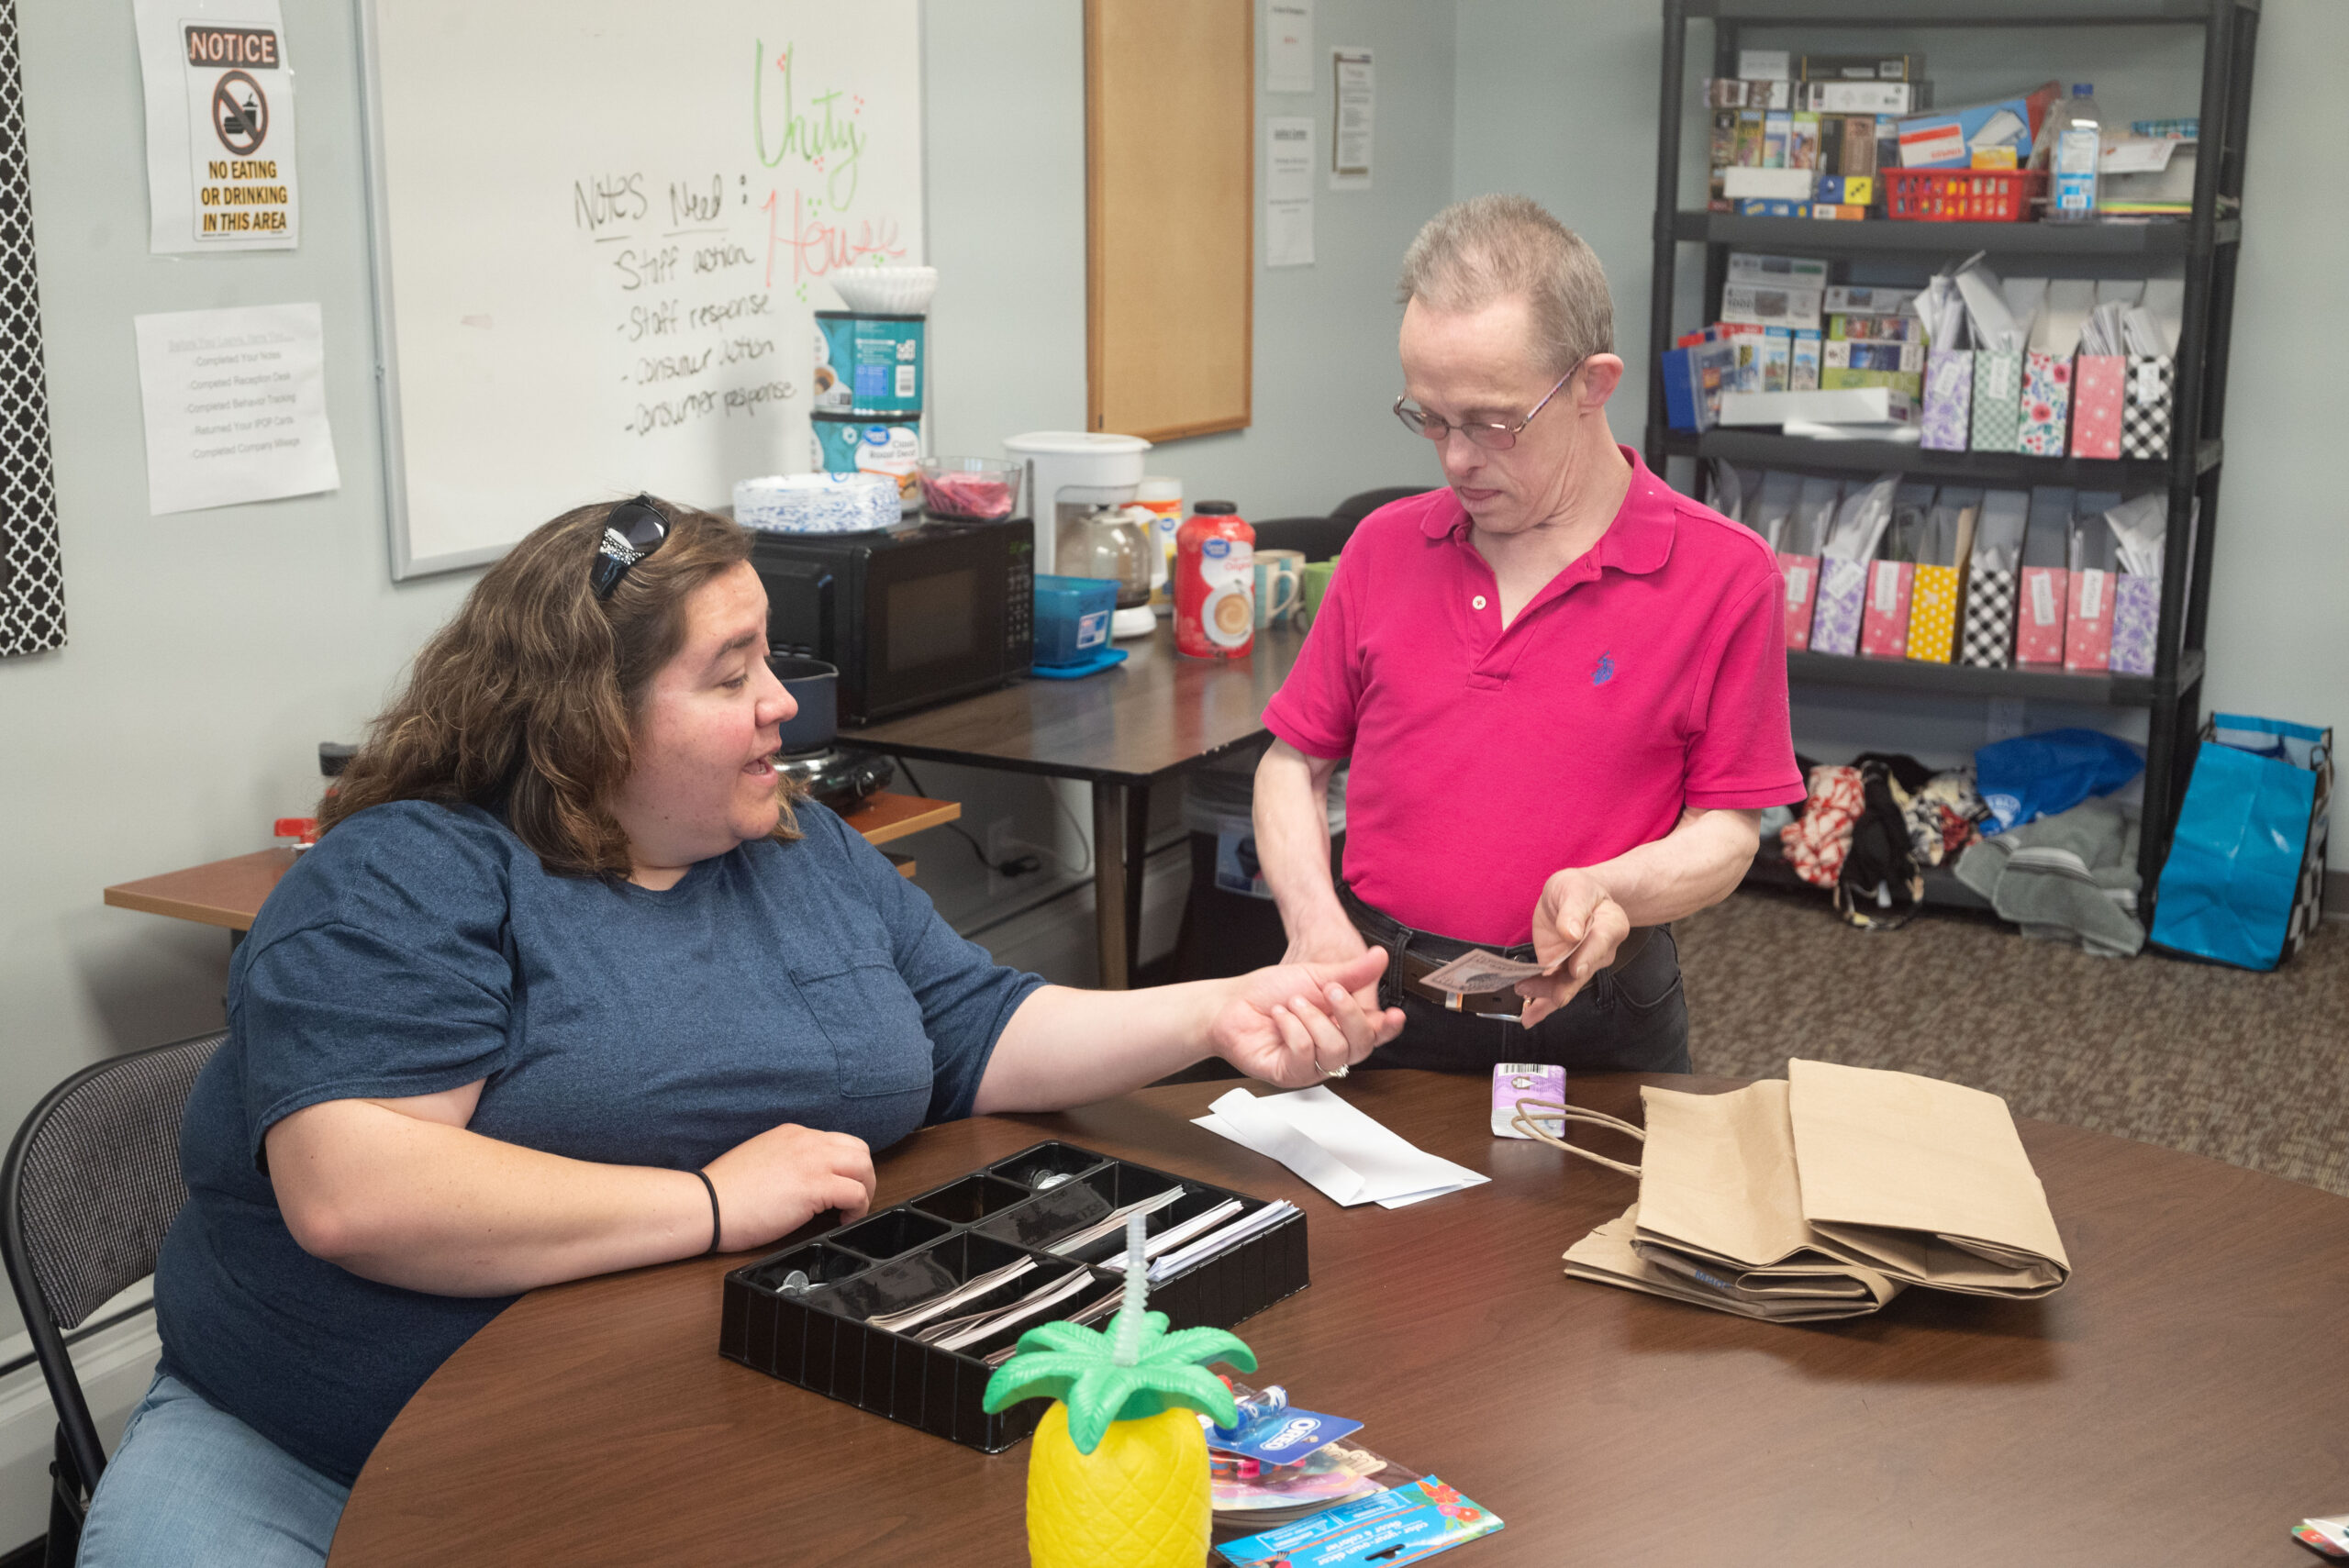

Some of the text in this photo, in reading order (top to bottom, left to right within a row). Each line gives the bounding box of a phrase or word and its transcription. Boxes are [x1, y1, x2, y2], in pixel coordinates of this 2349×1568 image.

[189, 31, 277, 63] NOTICE
[753, 38, 866, 212] Unity
[208, 160, 277, 179] NO EATING
[201, 185, 288, 206] OR DRINKING
[203, 211, 286, 231] IN THIS AREA
[760, 188, 907, 288] House
[614, 244, 679, 291] Staff
[689, 294, 774, 332] response
[723, 382, 798, 418] response
[1264, 1418, 1318, 1451] OREO
